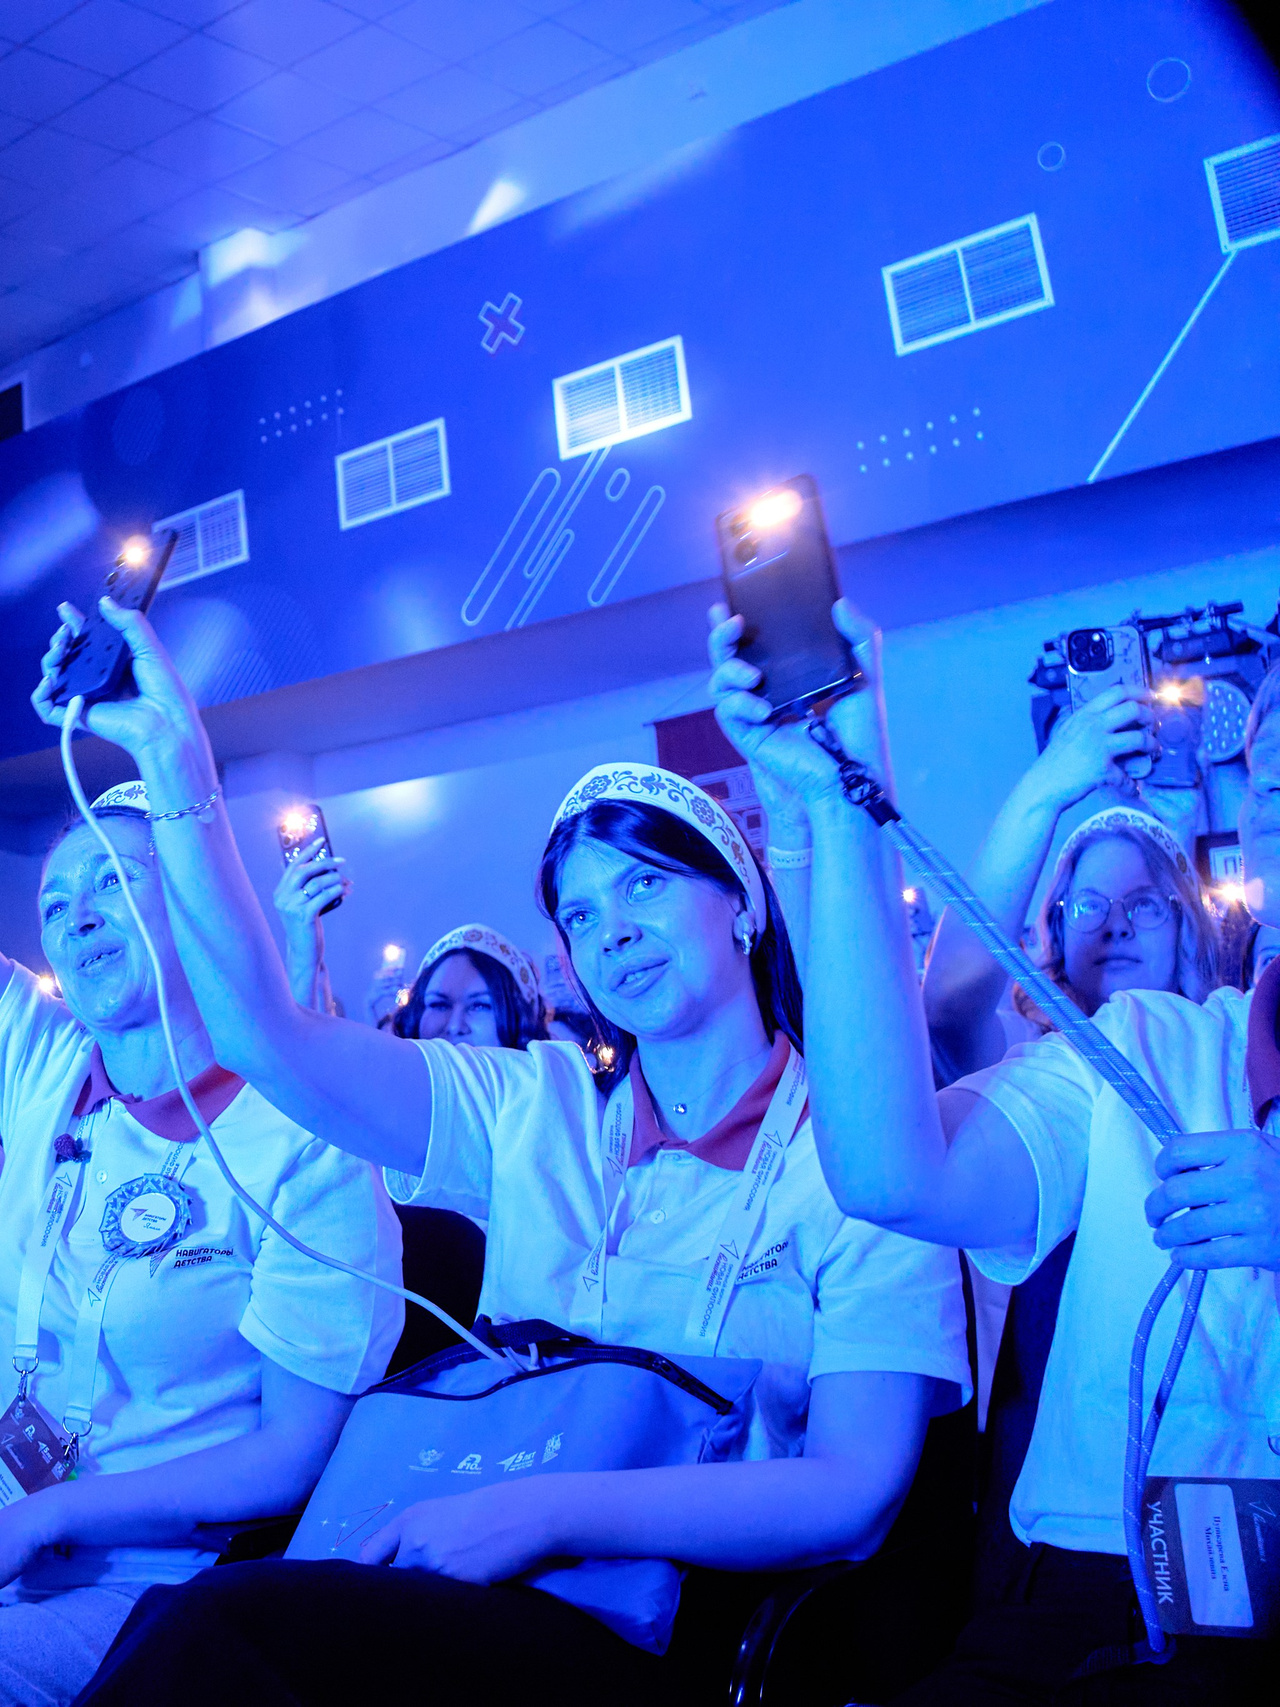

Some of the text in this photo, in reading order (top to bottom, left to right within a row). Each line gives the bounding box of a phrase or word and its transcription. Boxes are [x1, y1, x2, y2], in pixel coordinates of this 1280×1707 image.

[744, 1170, 764, 1211] ФИЛОСОФИЯ
[173, 1255, 212, 1269] ДЕТСТВА
[175, 1248, 234, 1257] НАВИГАТОРЫ
[699, 1262, 728, 1337] НОВАЯ ФИЛОСОФИЯ
[1146, 1501, 1174, 1604] УЧАСТНИК
